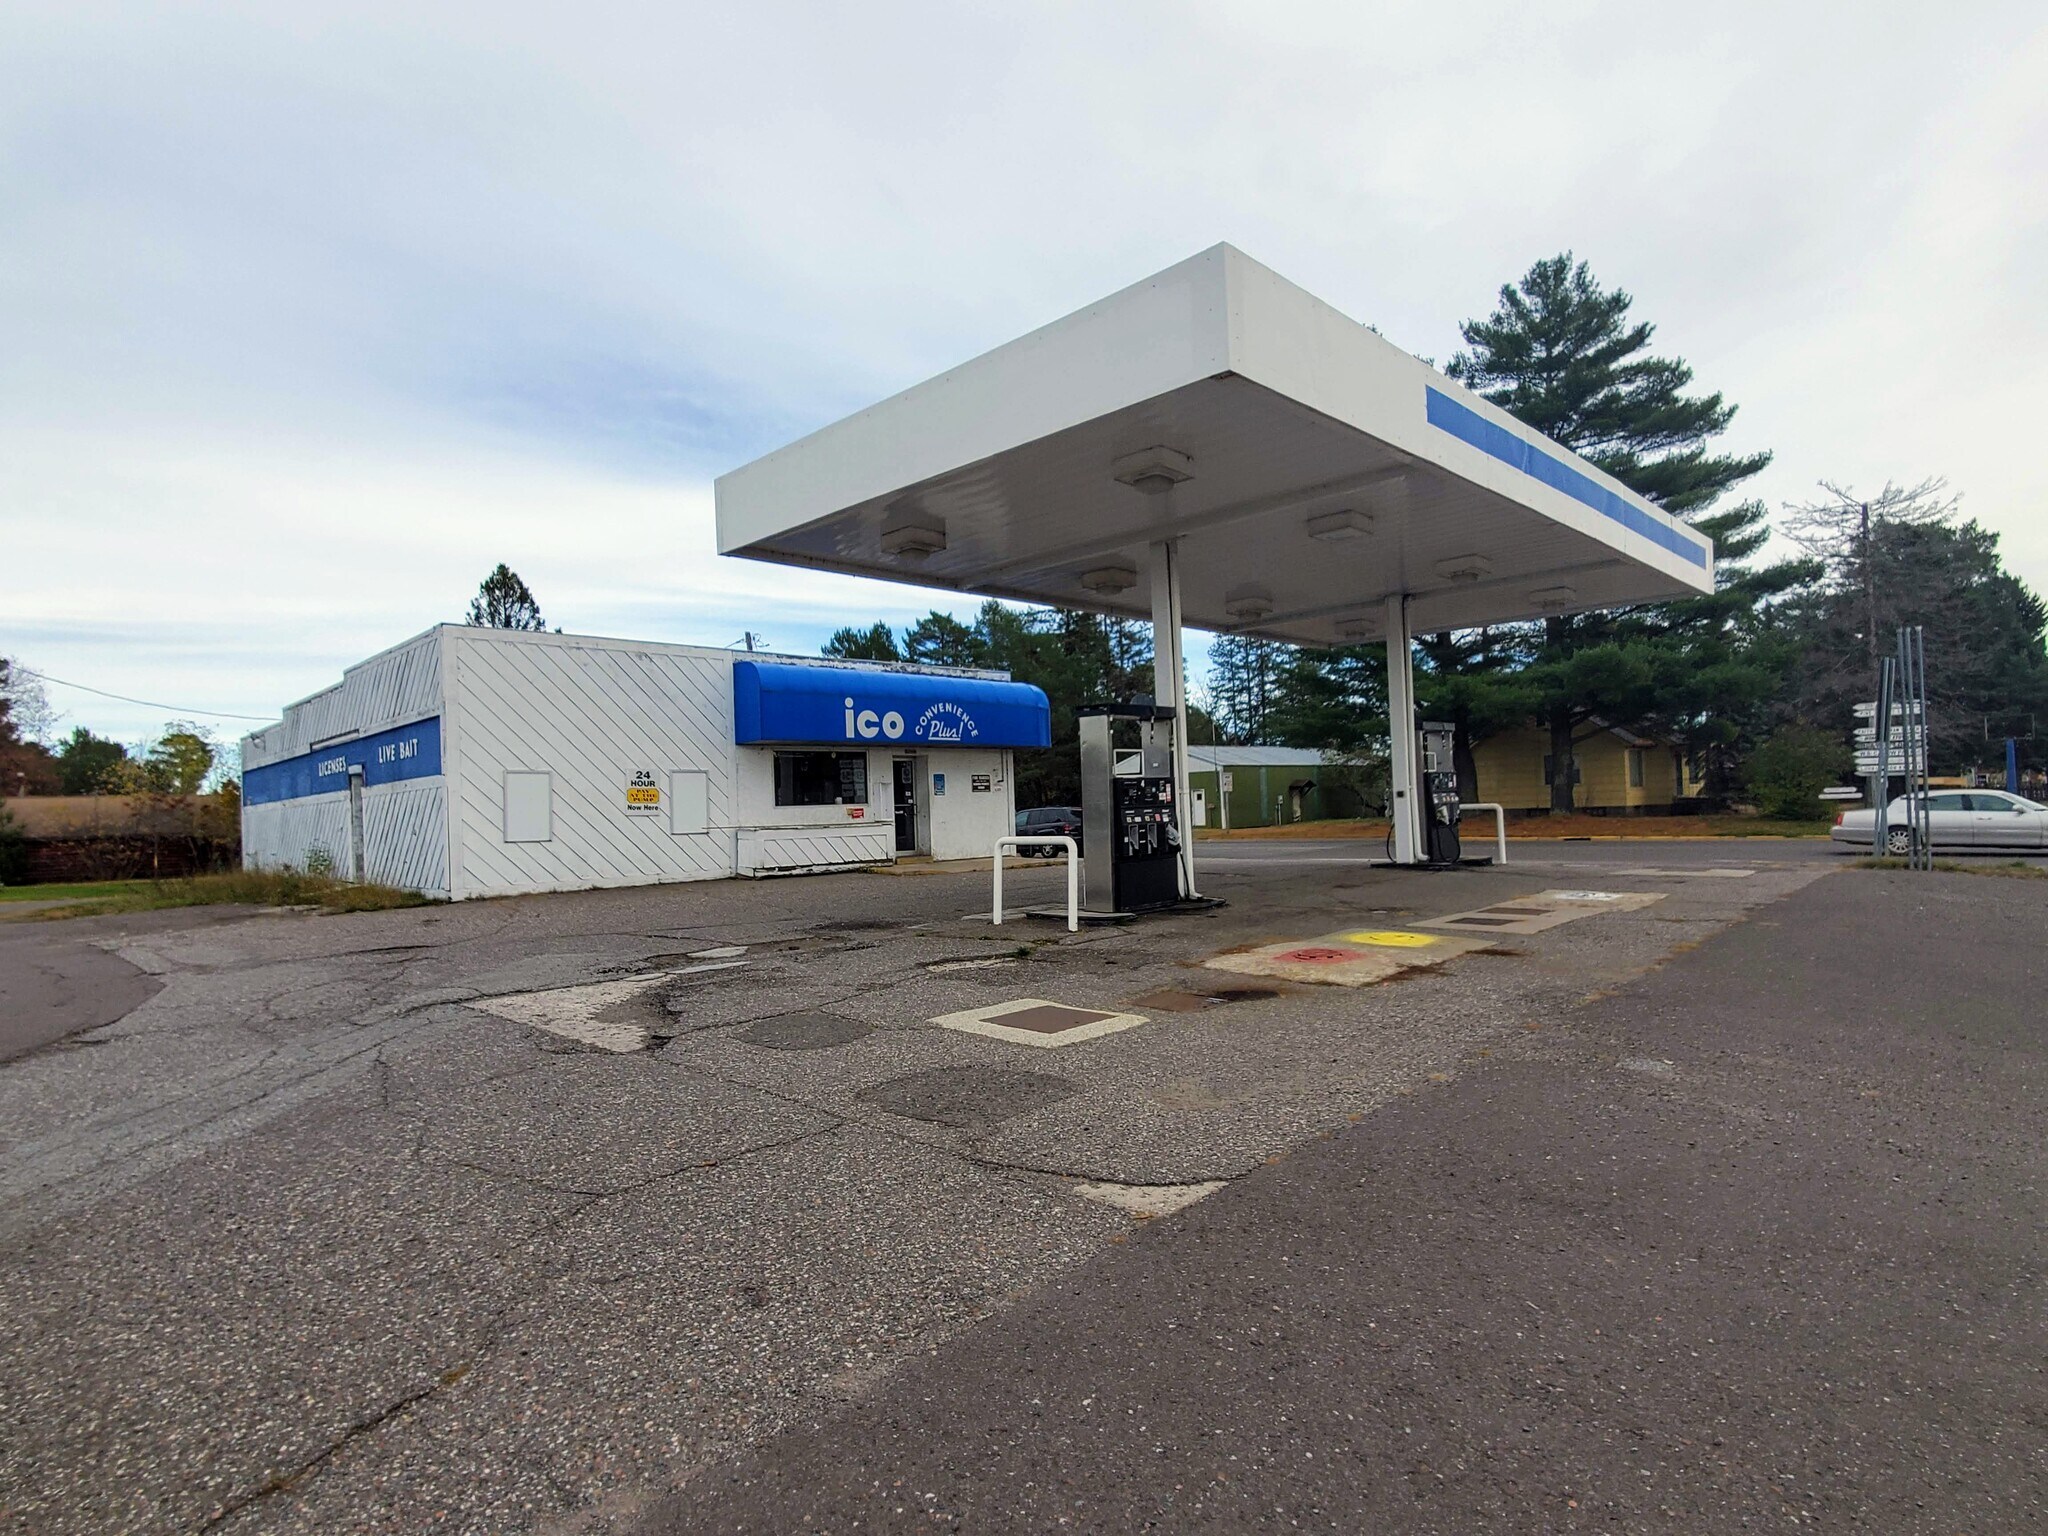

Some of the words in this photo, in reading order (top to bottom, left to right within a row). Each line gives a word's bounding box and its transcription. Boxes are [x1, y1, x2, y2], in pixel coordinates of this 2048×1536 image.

[844, 696, 905, 739] ico
[915, 702, 979, 737] CONVENIENCE
[928, 720, 964, 738] Plus!
[378, 744, 396, 764] LIVE
[399, 738, 419, 760] BAIT
[318, 756, 346, 776] LICENSES
[635, 770, 651, 780] 24
